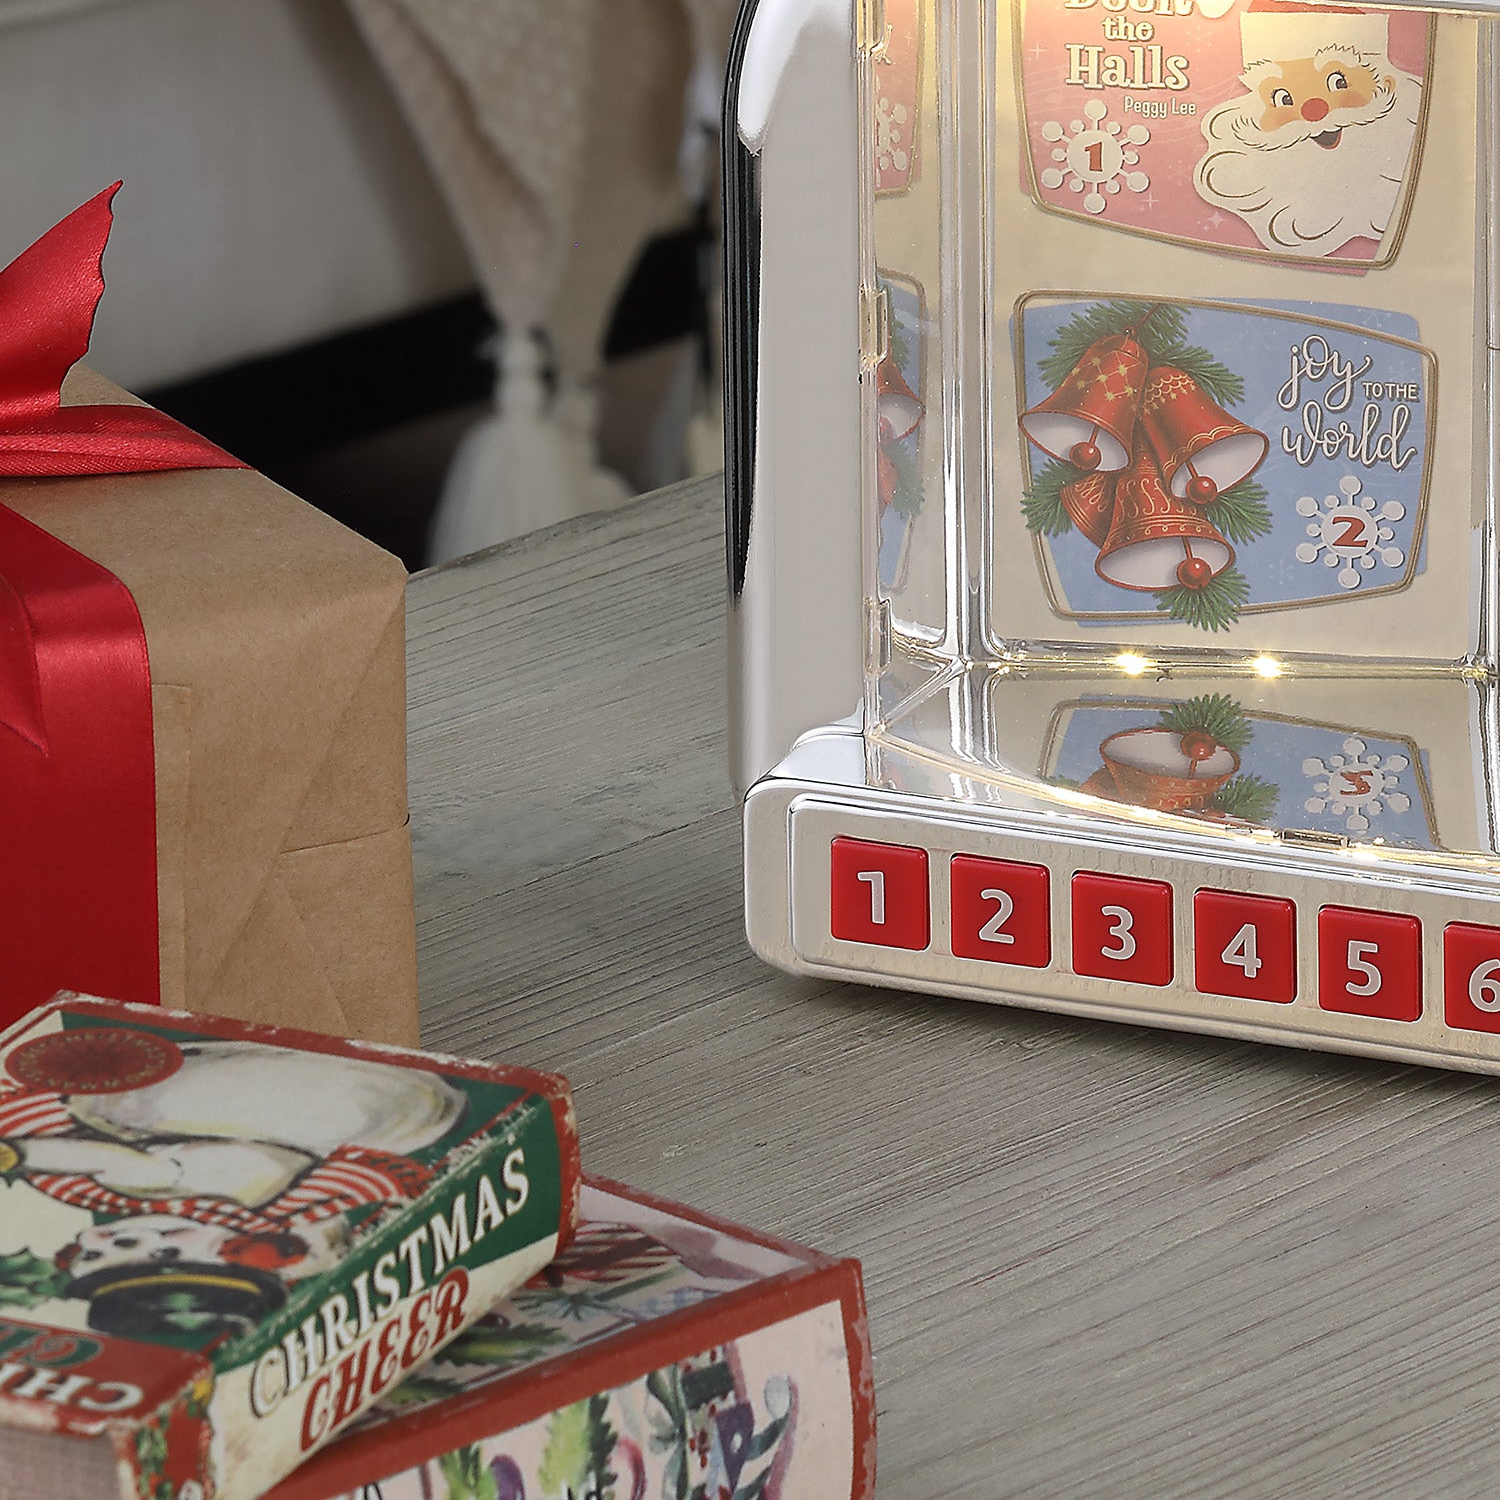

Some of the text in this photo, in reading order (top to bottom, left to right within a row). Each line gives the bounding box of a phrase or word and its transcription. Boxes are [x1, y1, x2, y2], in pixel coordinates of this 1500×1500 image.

[1102, 15, 1155, 41] the
[1065, 44, 1191, 91] Halls
[1124, 96, 1197, 118] Peggy Lee
[1083, 141, 1103, 172] 1
[1362, 381, 1419, 400] TO THE
[1331, 515, 1369, 548] 2
[856, 869, 886, 925] 1
[978, 888, 1015, 944] 2
[1100, 904, 1138, 961] 3
[1220, 923, 1263, 979] 4
[1344, 940, 1383, 997] 5
[249, 1147, 530, 1420] CHRISTMAS
[300, 1266, 470, 1453] CHEER
